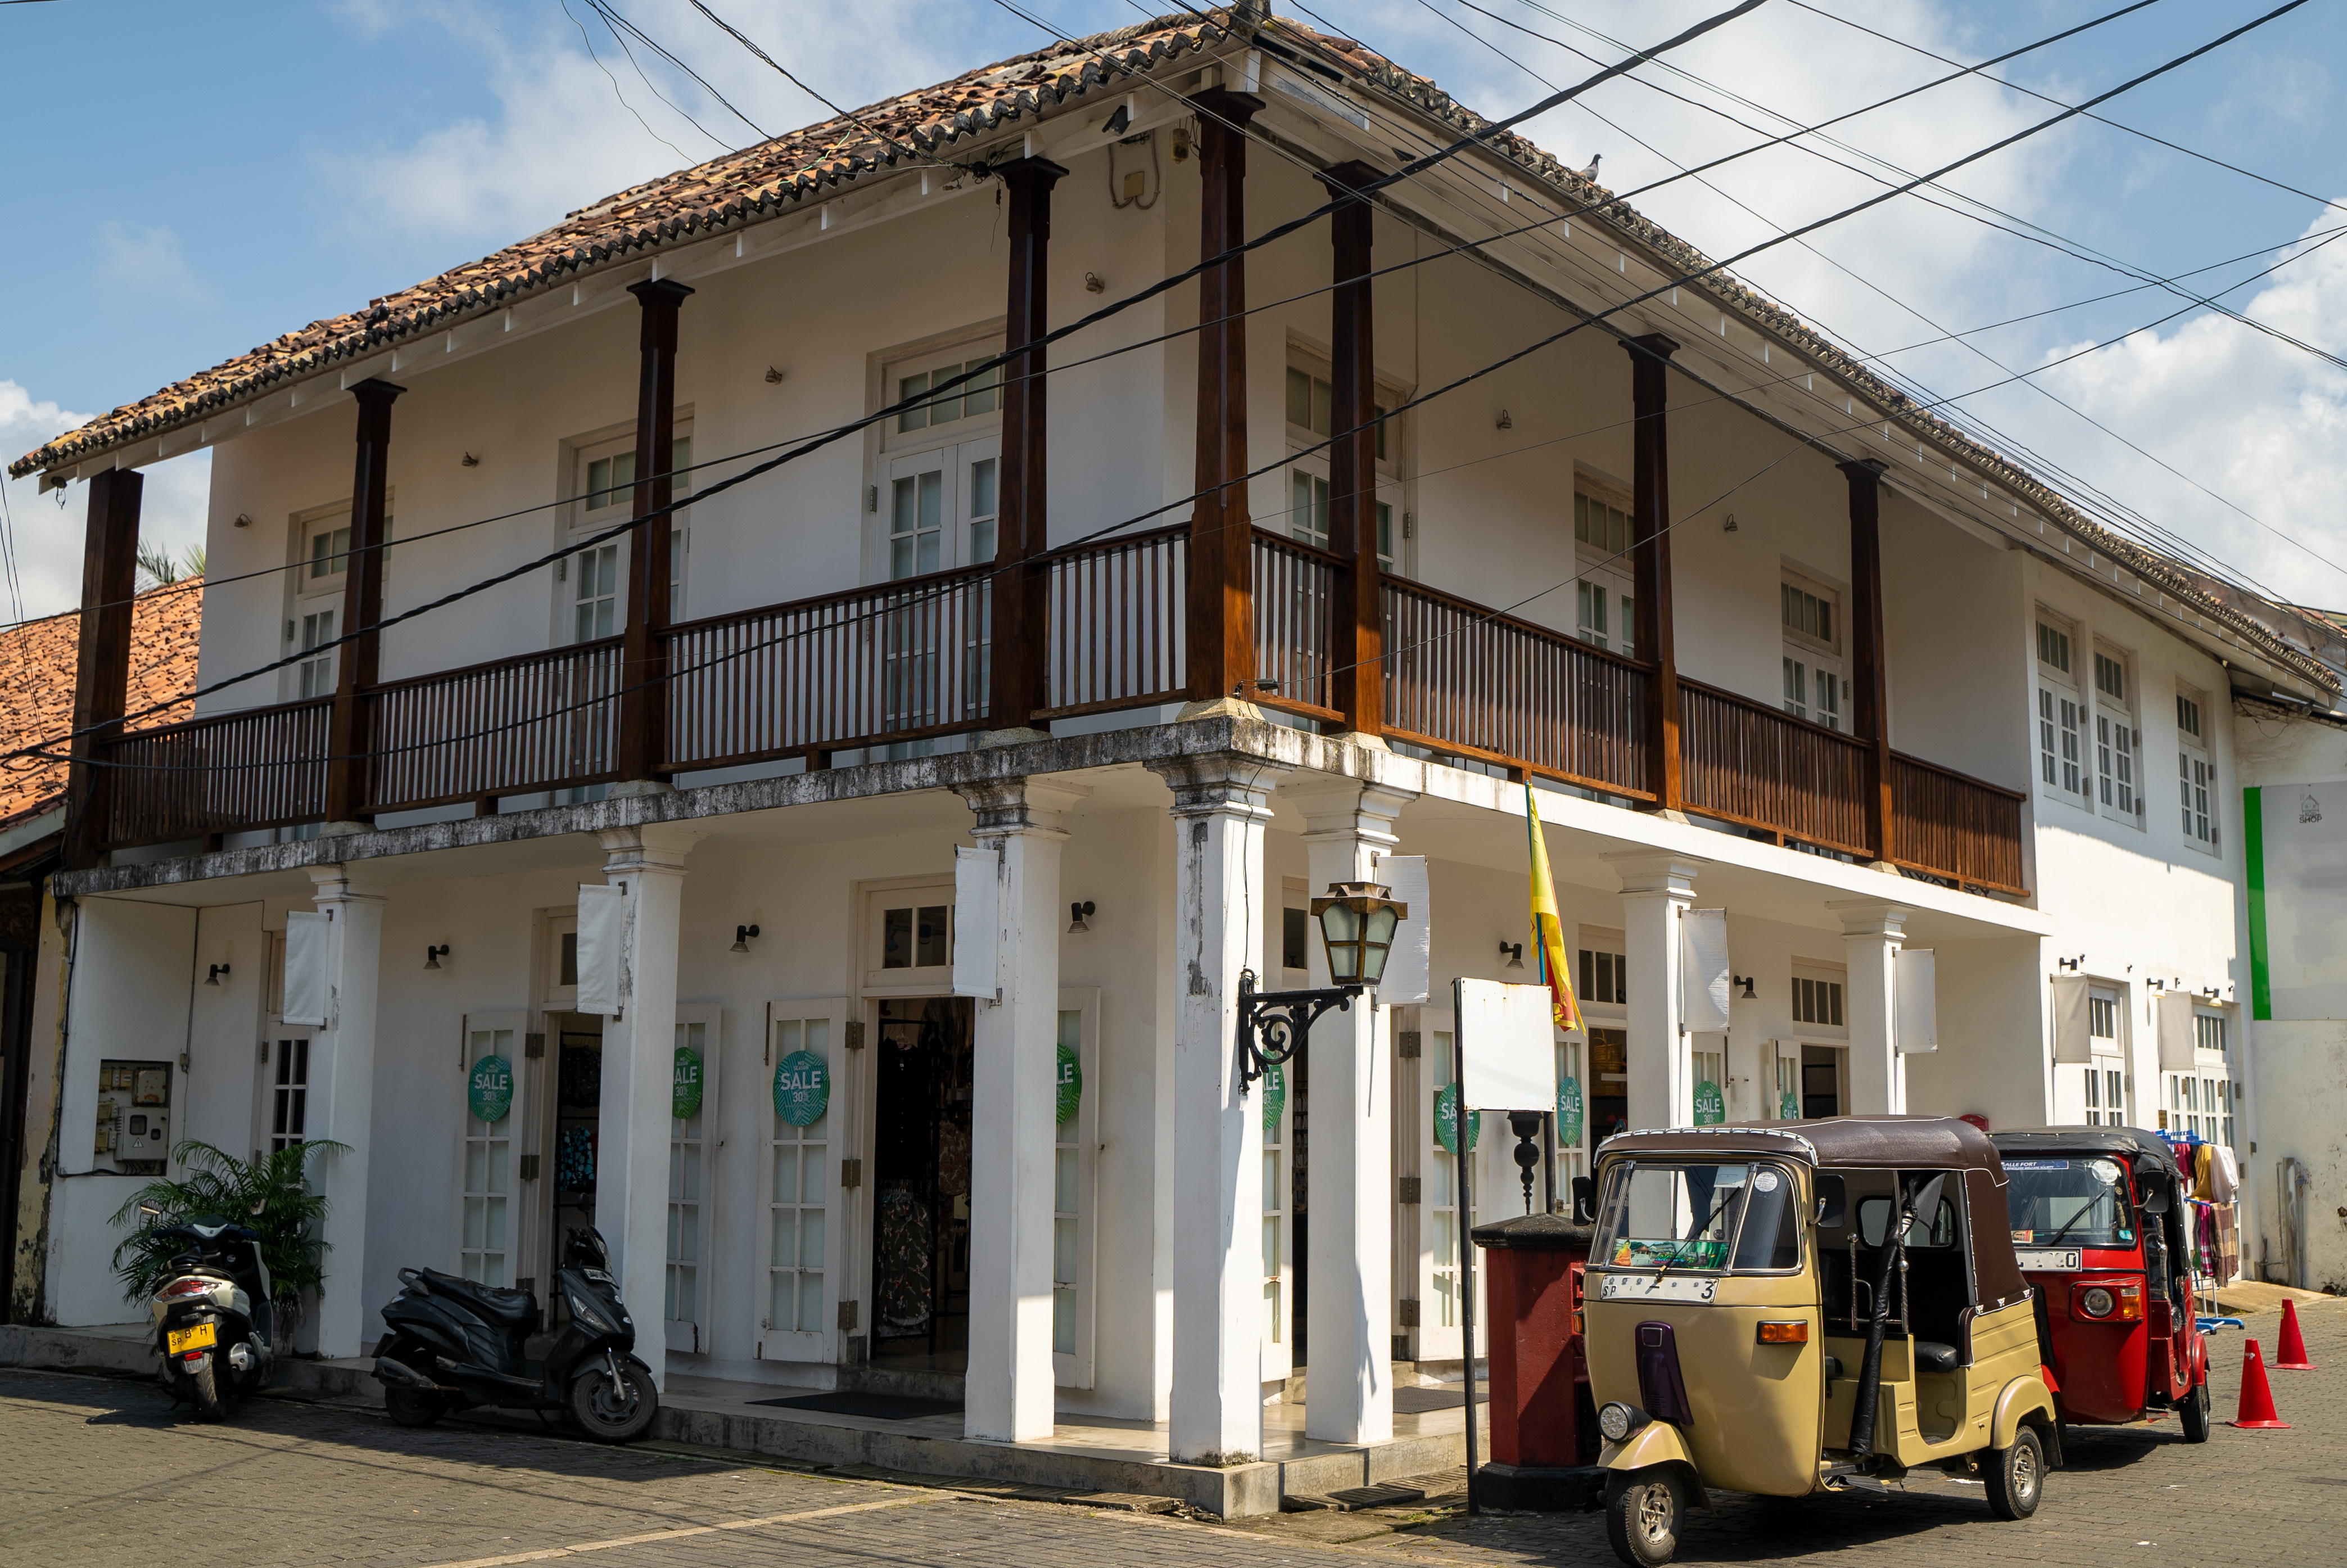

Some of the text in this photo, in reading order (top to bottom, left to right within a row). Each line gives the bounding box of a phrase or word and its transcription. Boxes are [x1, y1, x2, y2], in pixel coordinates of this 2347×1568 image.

[474, 1073, 508, 1090] SALE
[674, 1066, 697, 1085] ALE
[780, 1071, 821, 1091] SALE
[1441, 1102, 1473, 1120] SAE
[1561, 1095, 1580, 1113] SALE
[1696, 1098, 1720, 1113] SALE
[172, 1337, 182, 1346] SP
